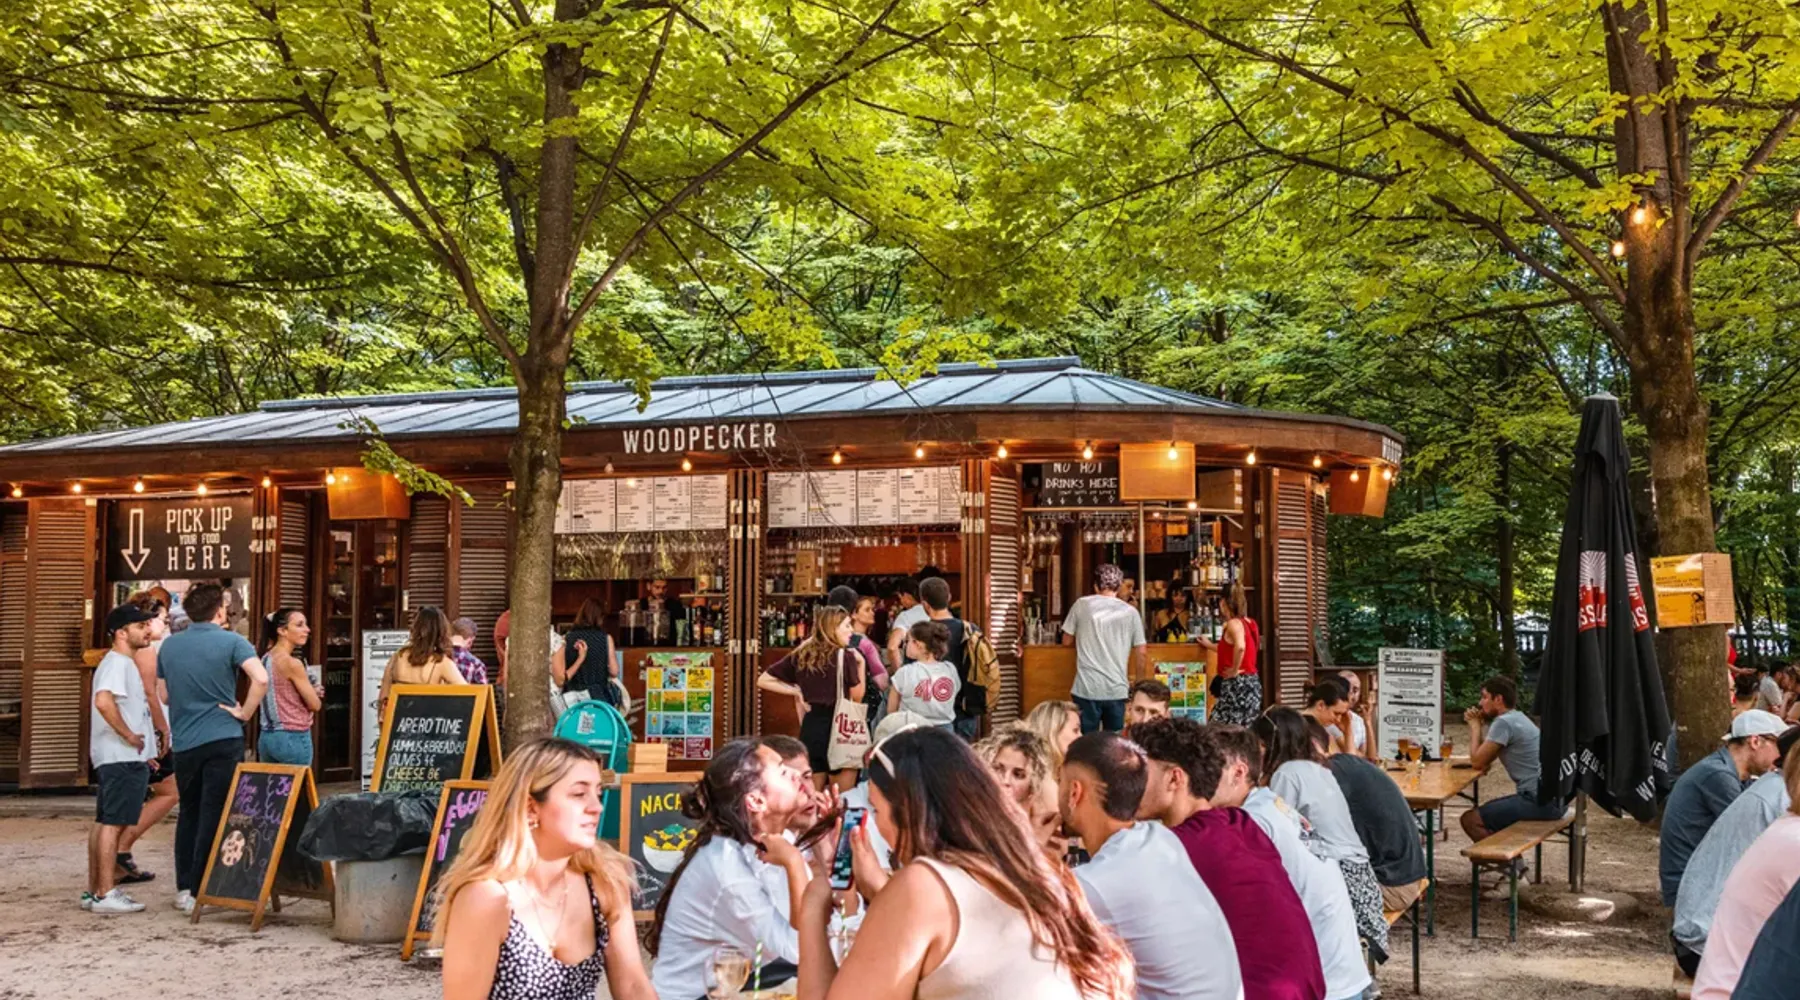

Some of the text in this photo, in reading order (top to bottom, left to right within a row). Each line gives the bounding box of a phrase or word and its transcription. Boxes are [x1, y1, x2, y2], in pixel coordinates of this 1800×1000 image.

[623, 422, 777, 454] WOODPECKER
[1045, 477, 1118, 489] DRINKS HERE
[166, 506, 233, 533] PICK UP
[179, 533, 220, 545] YOUR FOOD
[167, 545, 231, 571] HERE
[914, 676, 955, 702] 40
[396, 717, 463, 734] APERO TIME
[388, 753, 421, 767] OLIVES
[386, 766, 427, 780] CHEESE
